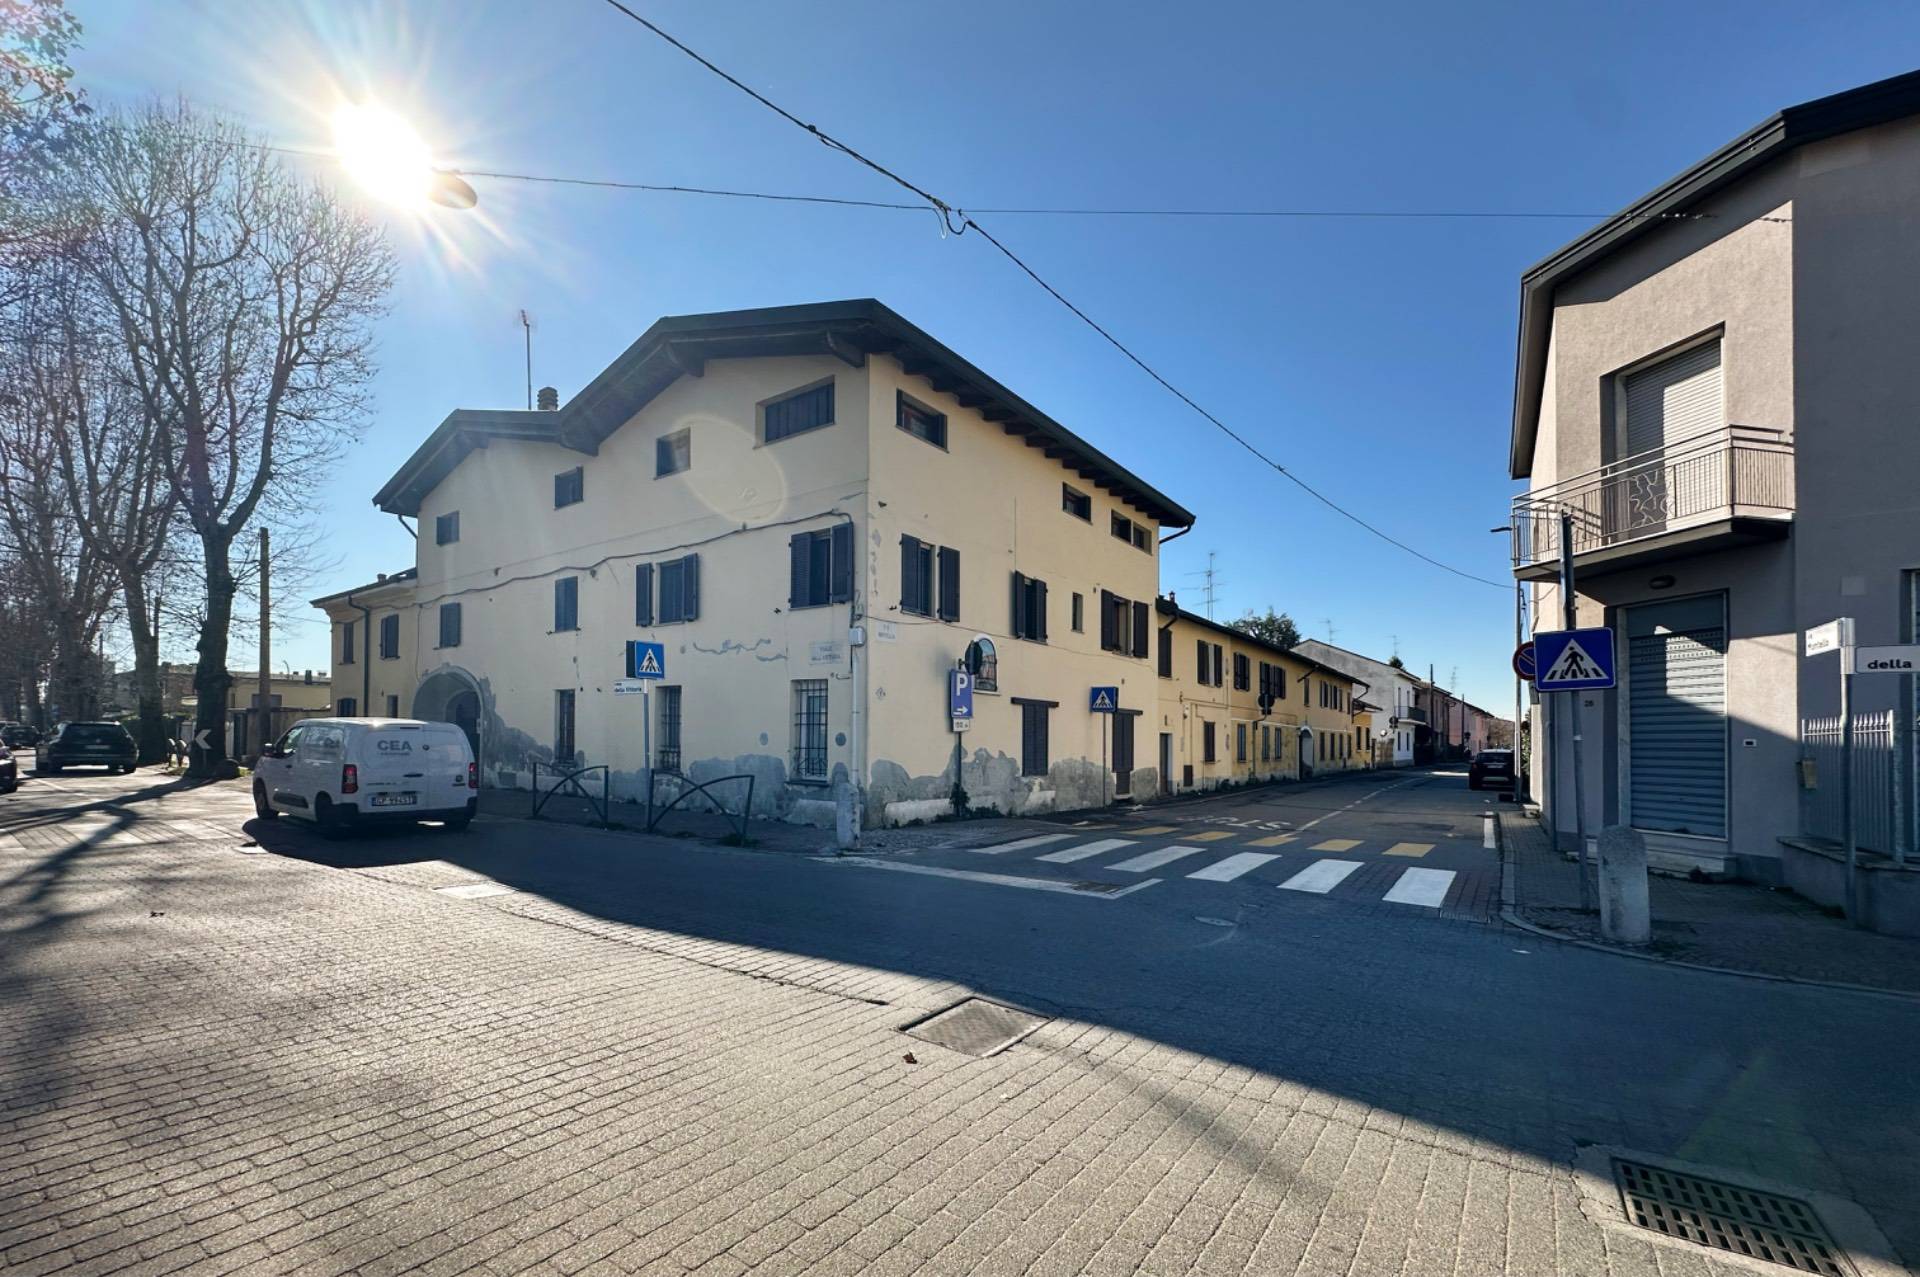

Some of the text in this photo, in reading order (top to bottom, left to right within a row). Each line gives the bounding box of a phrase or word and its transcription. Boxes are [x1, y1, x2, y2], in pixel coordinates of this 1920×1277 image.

[1867, 659, 1912, 670] della
[956, 673, 969, 696] P
[377, 740, 412, 751] CEA
